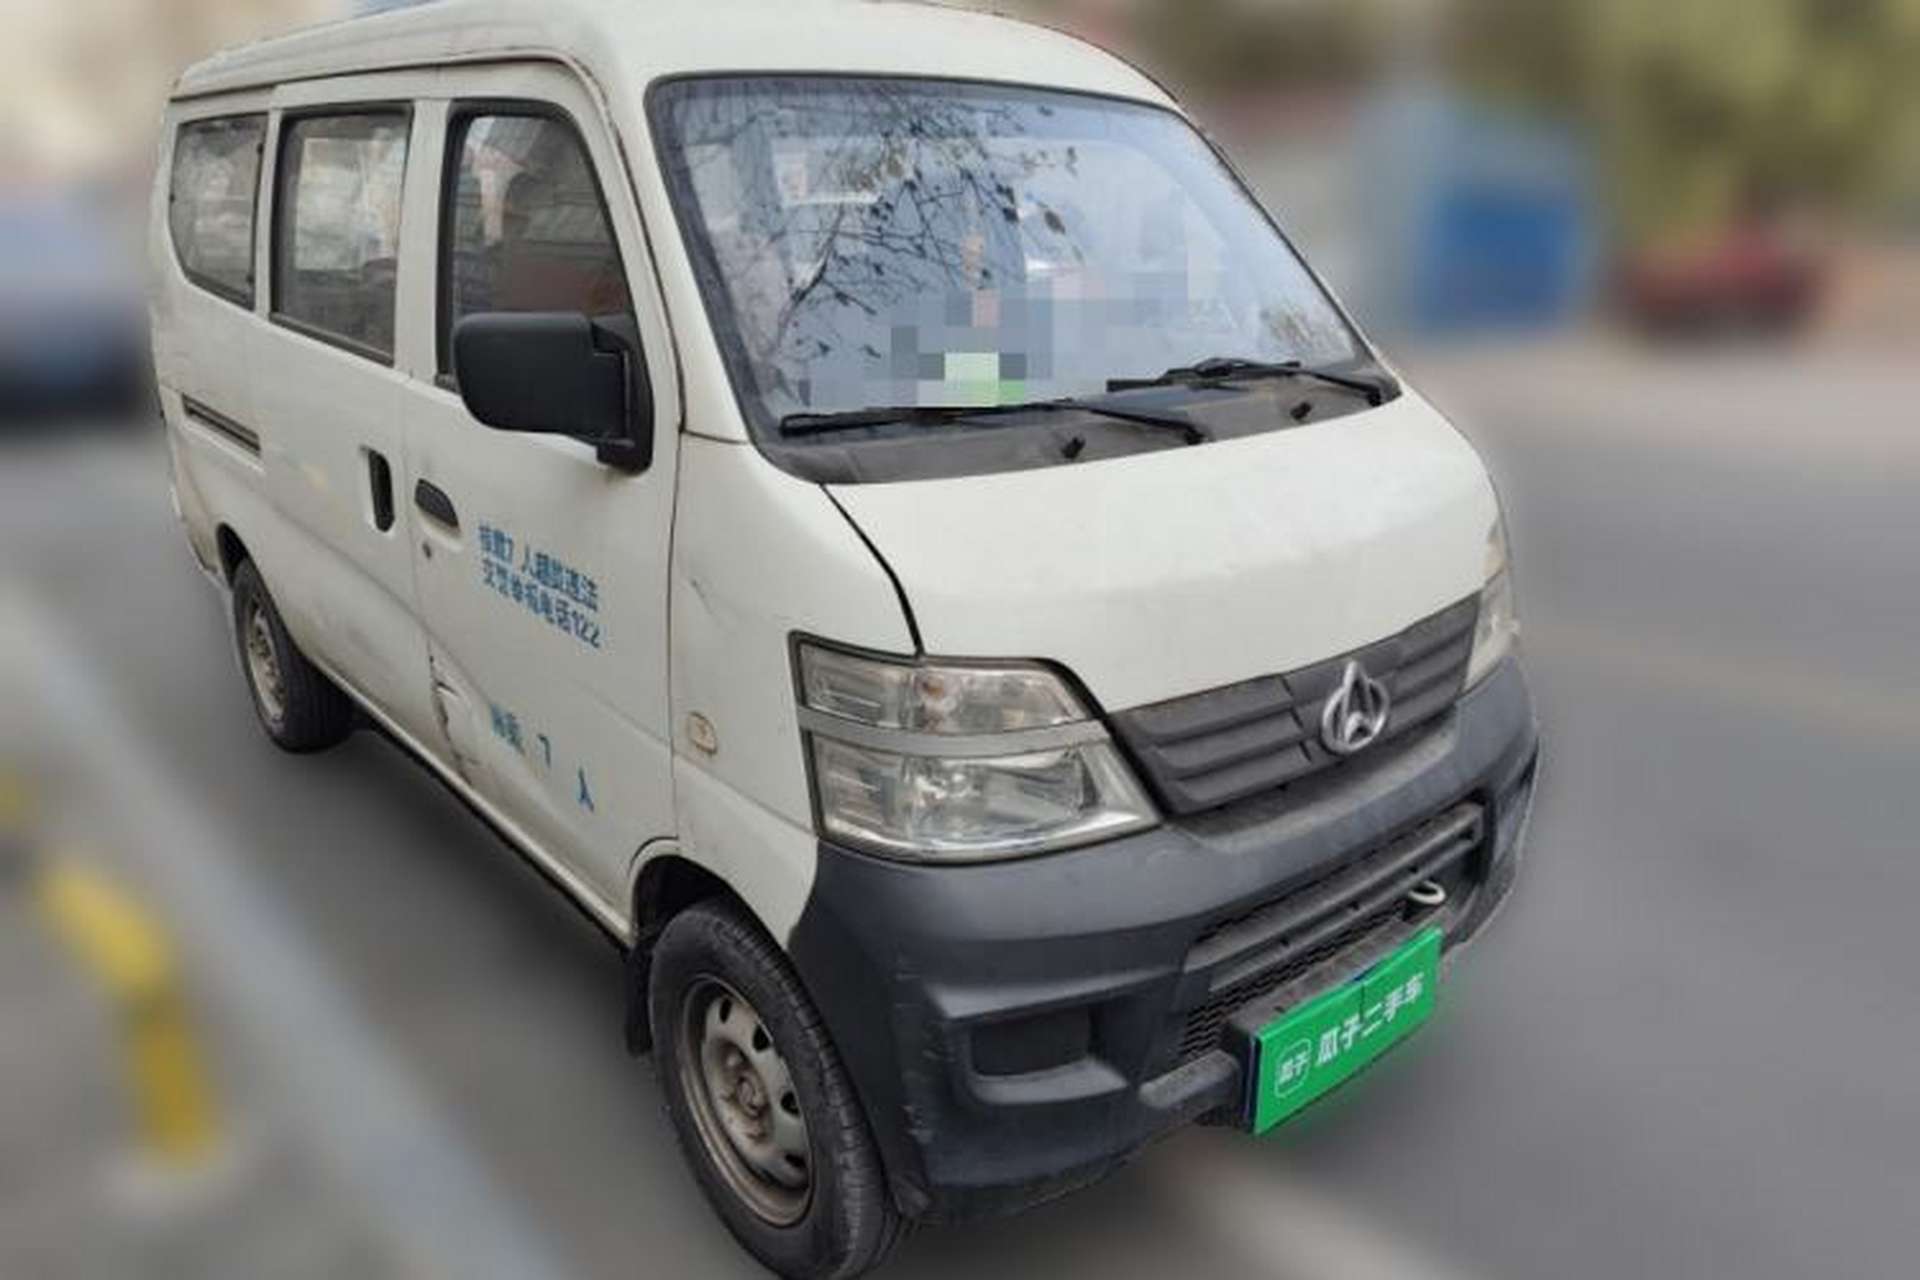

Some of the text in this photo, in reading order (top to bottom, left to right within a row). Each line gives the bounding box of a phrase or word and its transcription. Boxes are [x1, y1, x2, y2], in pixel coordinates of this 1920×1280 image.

[1316, 972, 1425, 1067] 瓜子二手车
